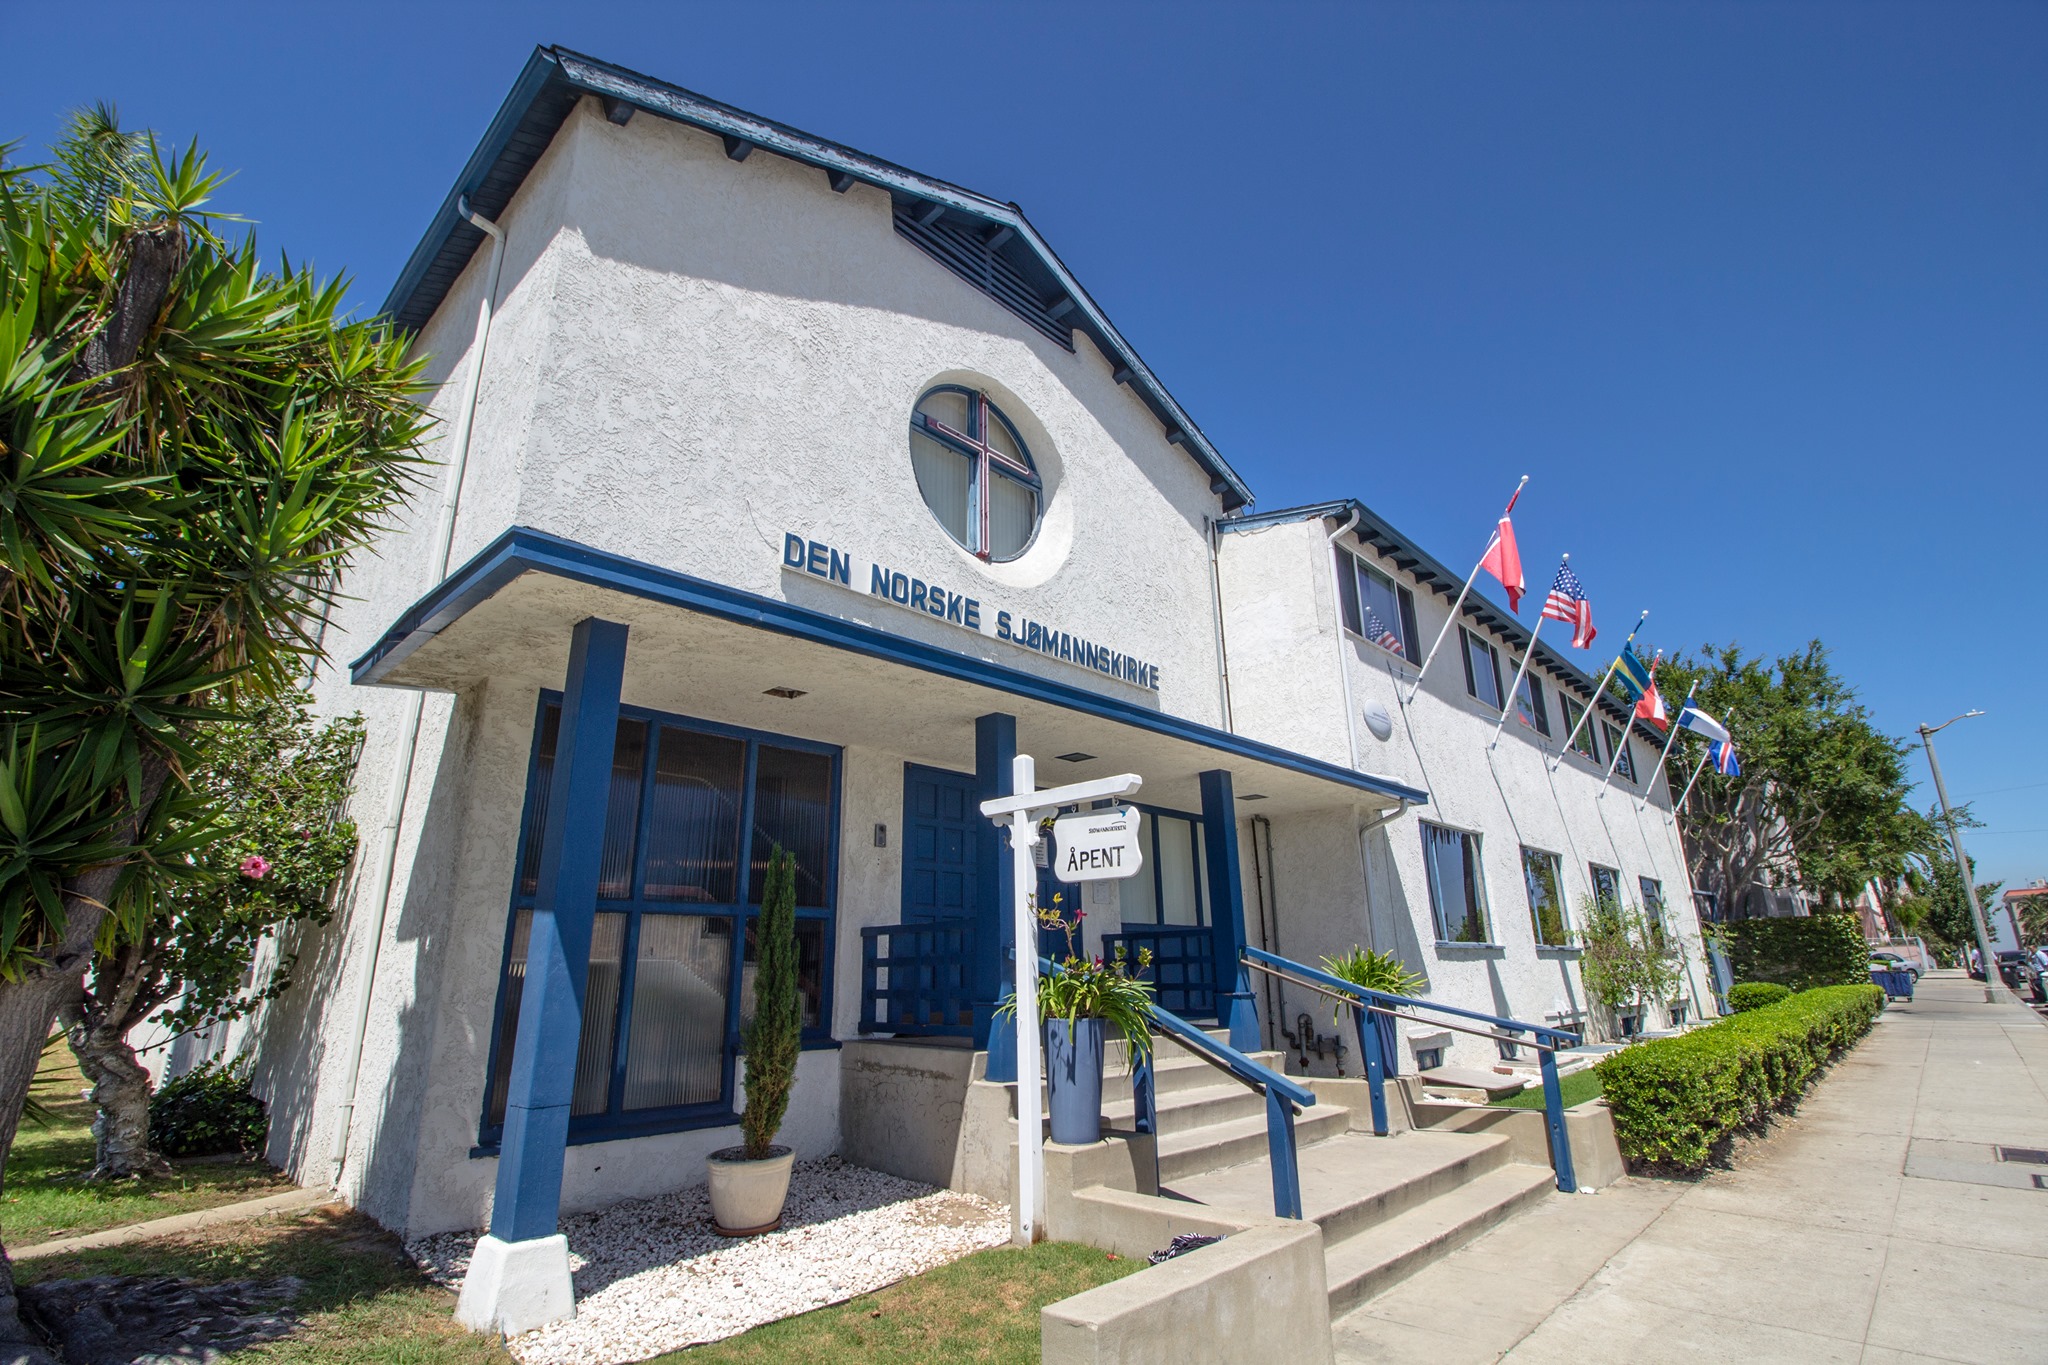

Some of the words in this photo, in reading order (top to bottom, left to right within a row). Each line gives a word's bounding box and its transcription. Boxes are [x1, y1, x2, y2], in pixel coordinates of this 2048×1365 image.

[783, 532, 850, 585] DEN
[870, 563, 980, 630] NORSKE
[997, 610, 1159, 691] SJØMANNSKIRKE
[1067, 845, 1125, 872] ÅPENT
